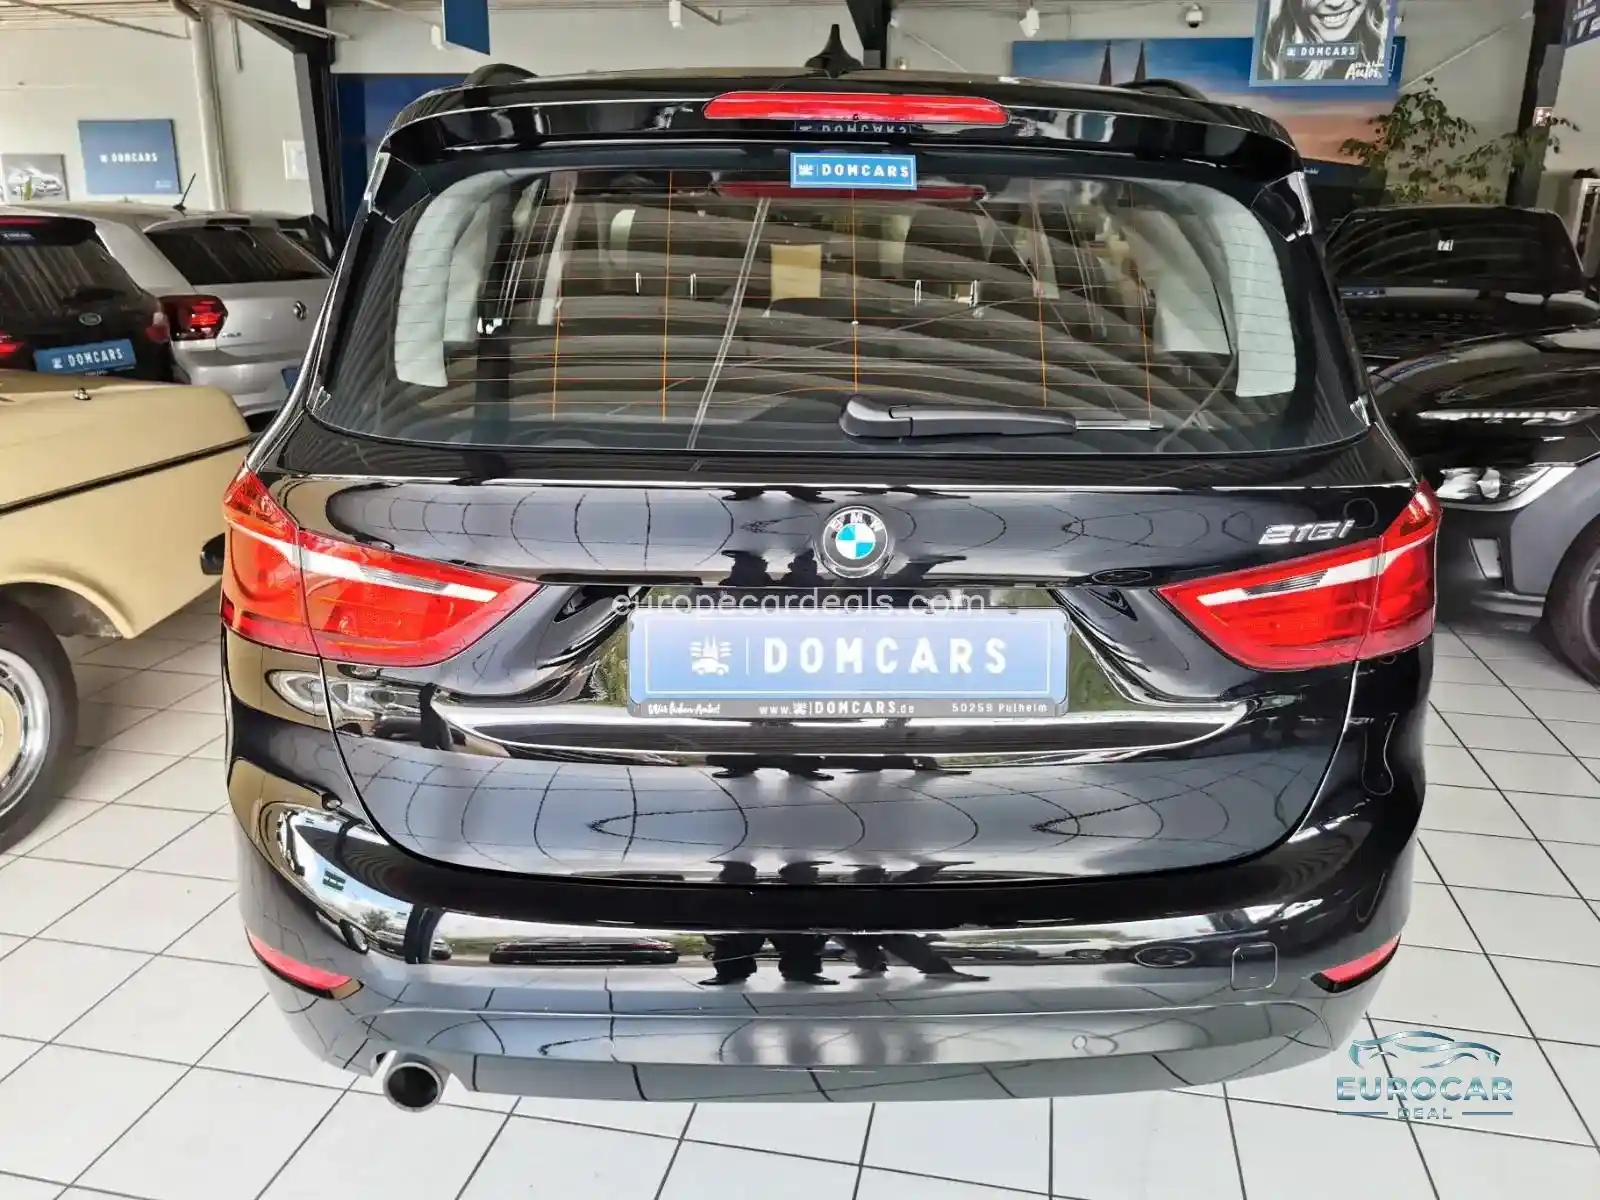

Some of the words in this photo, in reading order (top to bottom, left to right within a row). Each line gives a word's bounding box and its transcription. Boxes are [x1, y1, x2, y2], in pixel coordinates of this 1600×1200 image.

[1300, 45, 1356, 57] DOMCARS
[111, 152, 158, 163] DOMCARS
[821, 163, 909, 178] DOMCARS
[67, 348, 124, 367] DOMCARS
[831, 511, 884, 532] BMW
[764, 636, 1007, 675] DOMCARS
[999, 703, 1049, 713] Pulheim
